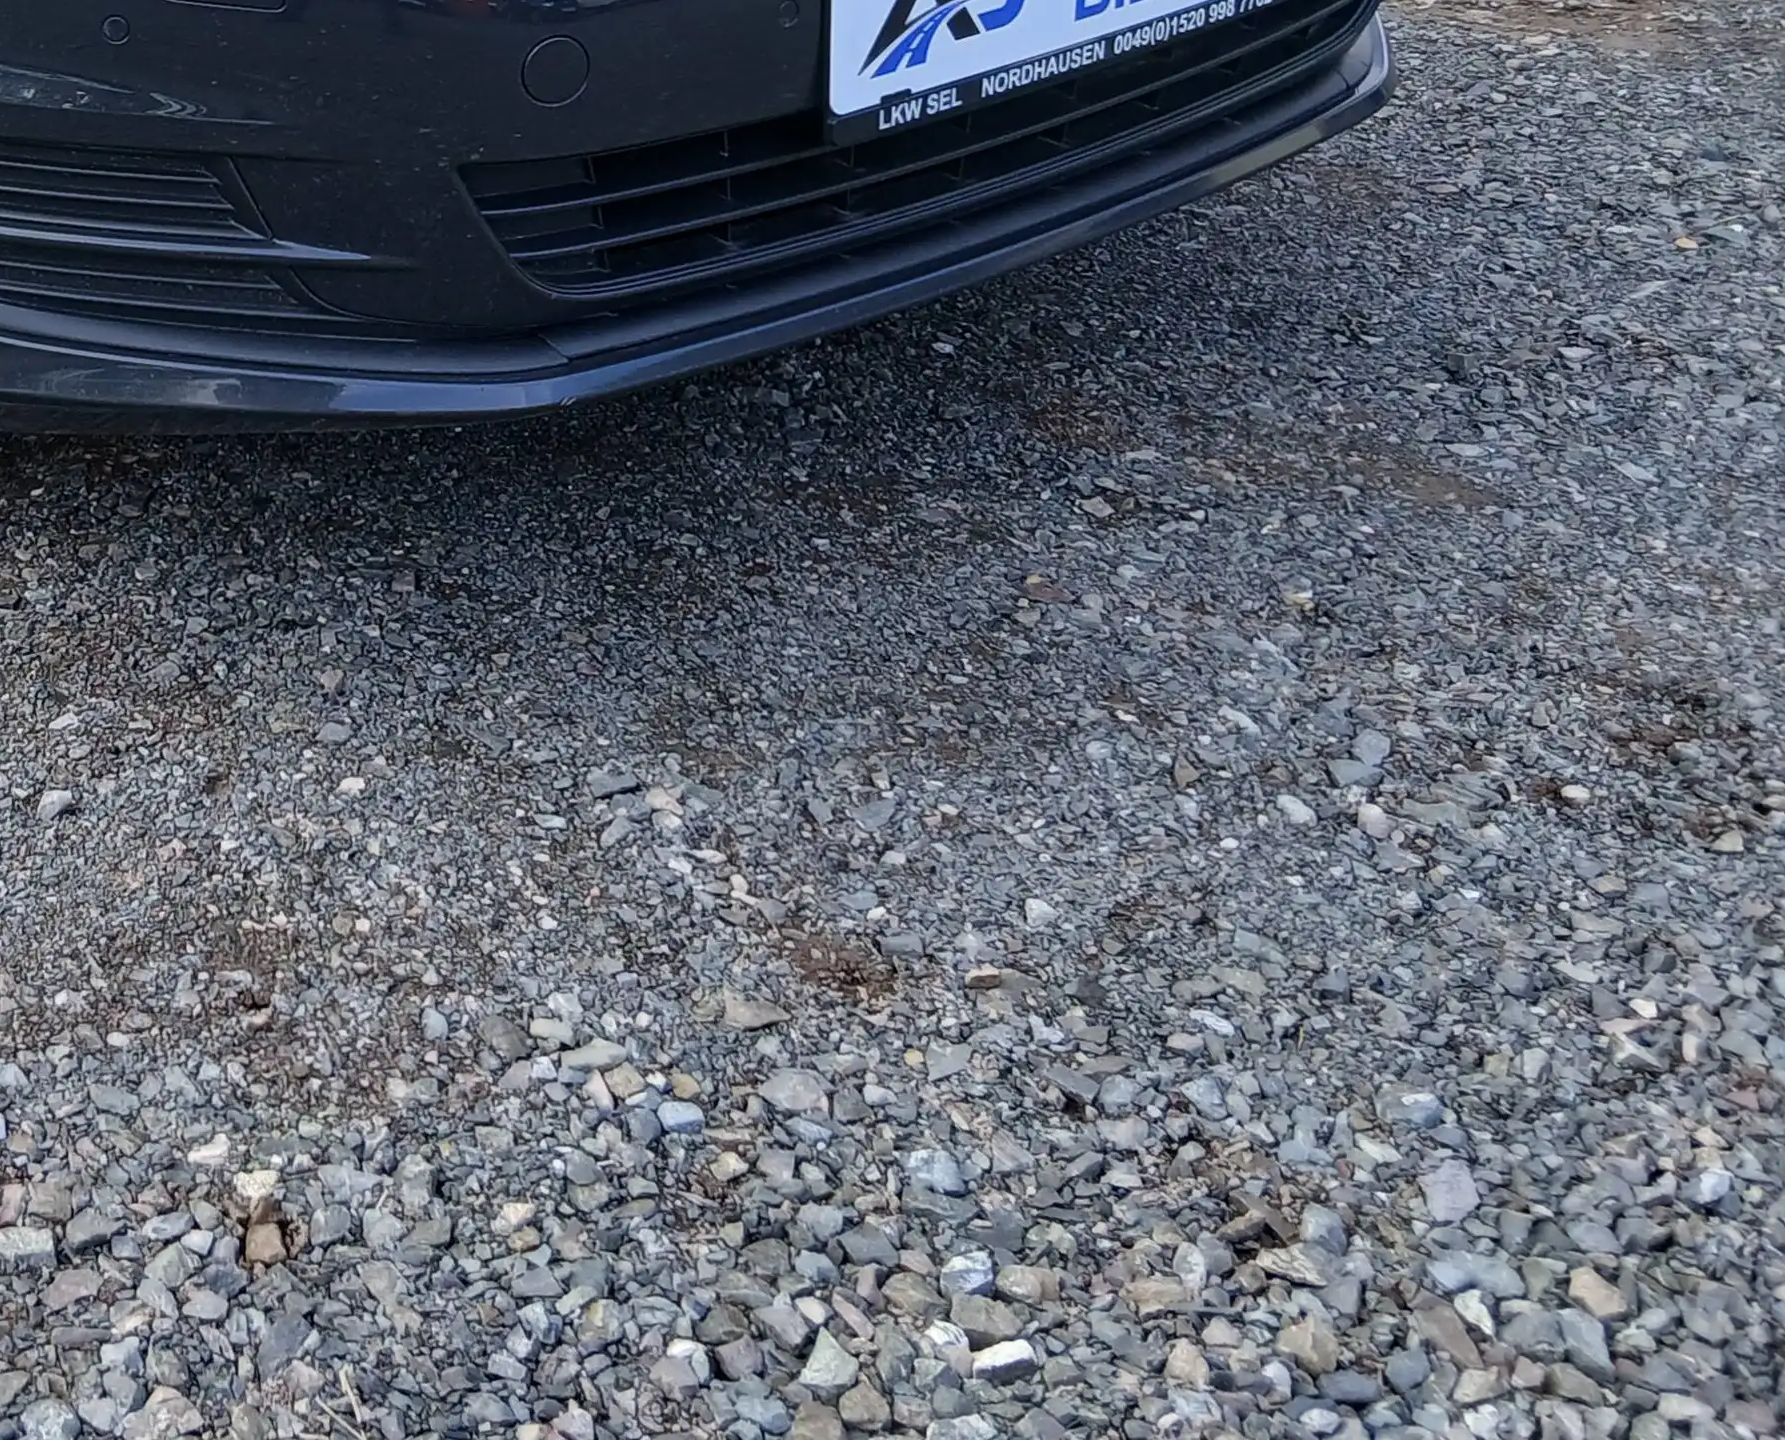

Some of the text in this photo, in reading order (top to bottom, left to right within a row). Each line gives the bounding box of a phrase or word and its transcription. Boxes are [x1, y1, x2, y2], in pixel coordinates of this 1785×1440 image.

[878, 96, 924, 131] LKW
[926, 86, 964, 116] SEL
[980, 39, 1107, 98] NORDHAUSEN
[1113, 8, 1207, 56] 0049(0)1520
